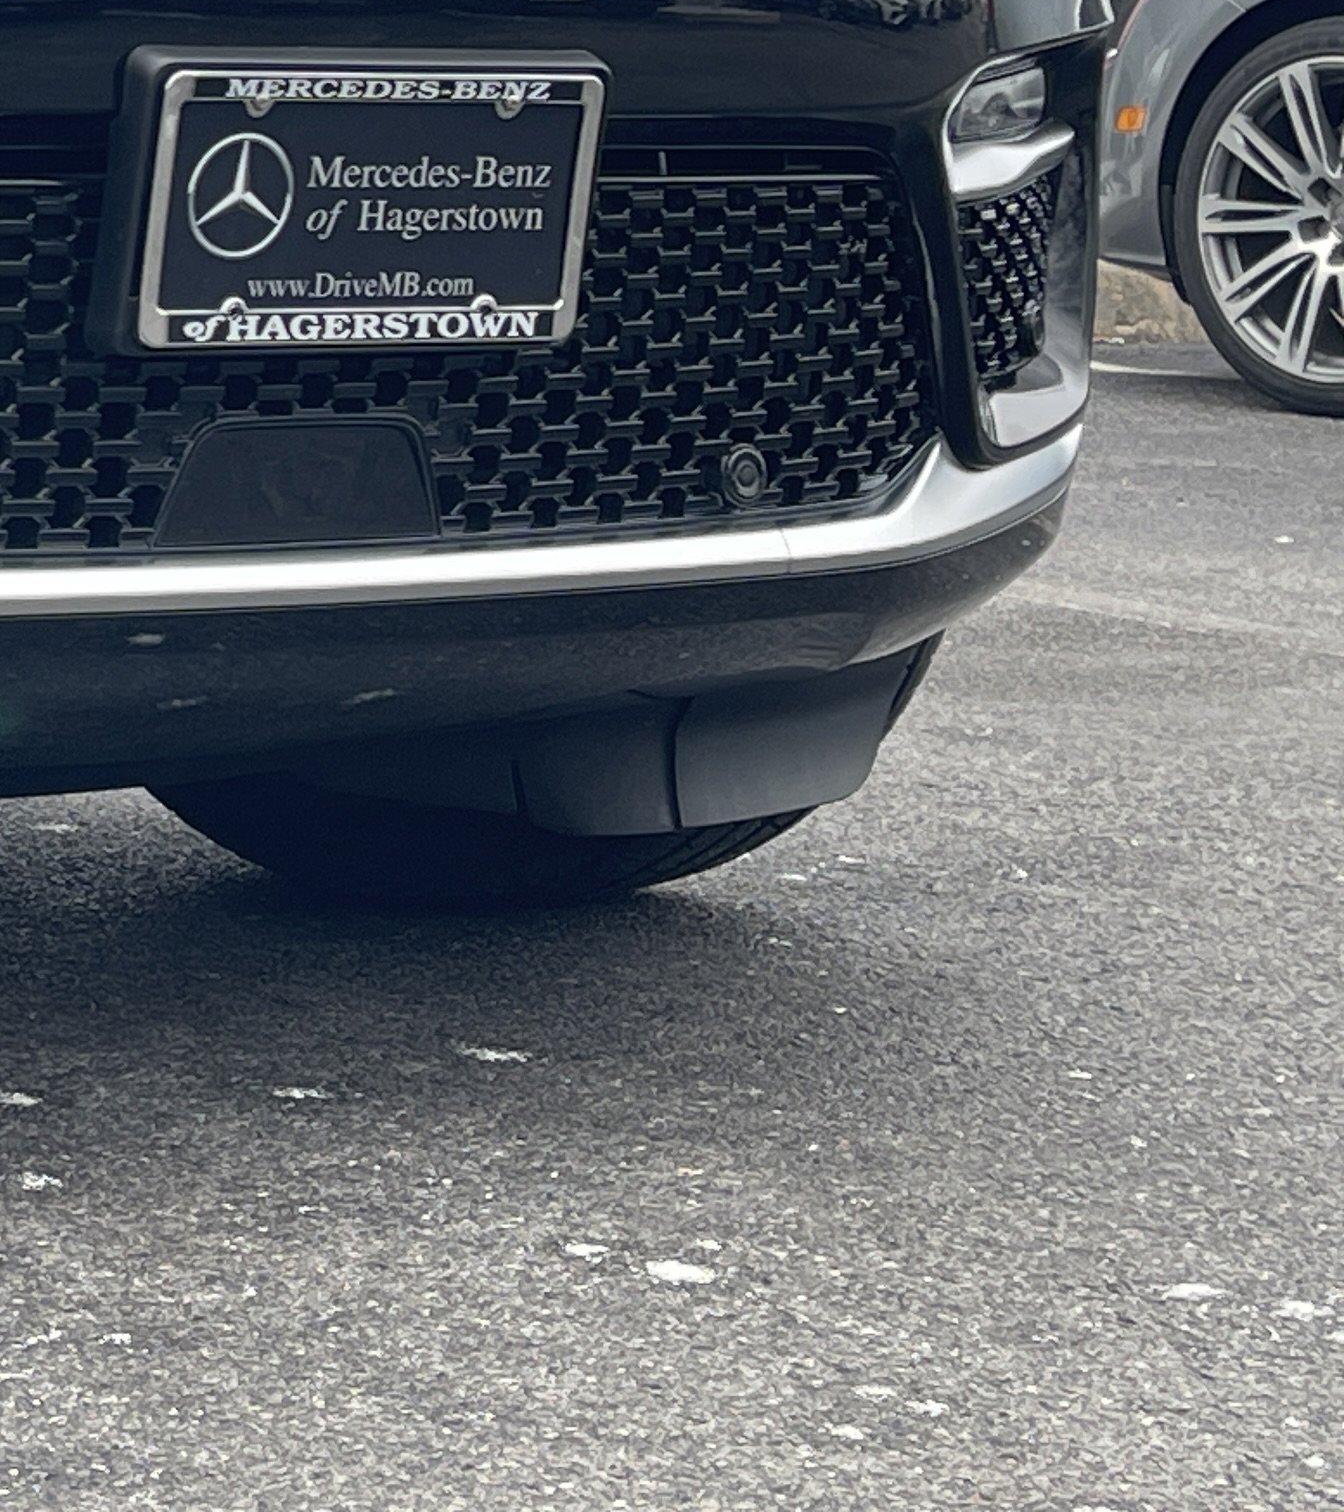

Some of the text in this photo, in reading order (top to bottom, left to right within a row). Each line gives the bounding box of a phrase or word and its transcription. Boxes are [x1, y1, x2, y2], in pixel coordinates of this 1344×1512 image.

[224, 77, 552, 102] MERCEDES-BENZ
[306, 155, 552, 189] Mercedes-Benz
[305, 199, 544, 241] of Hagerstown
[247, 271, 475, 298] www.DriveMB.com
[182, 311, 538, 342] of HAGERSTOWN
